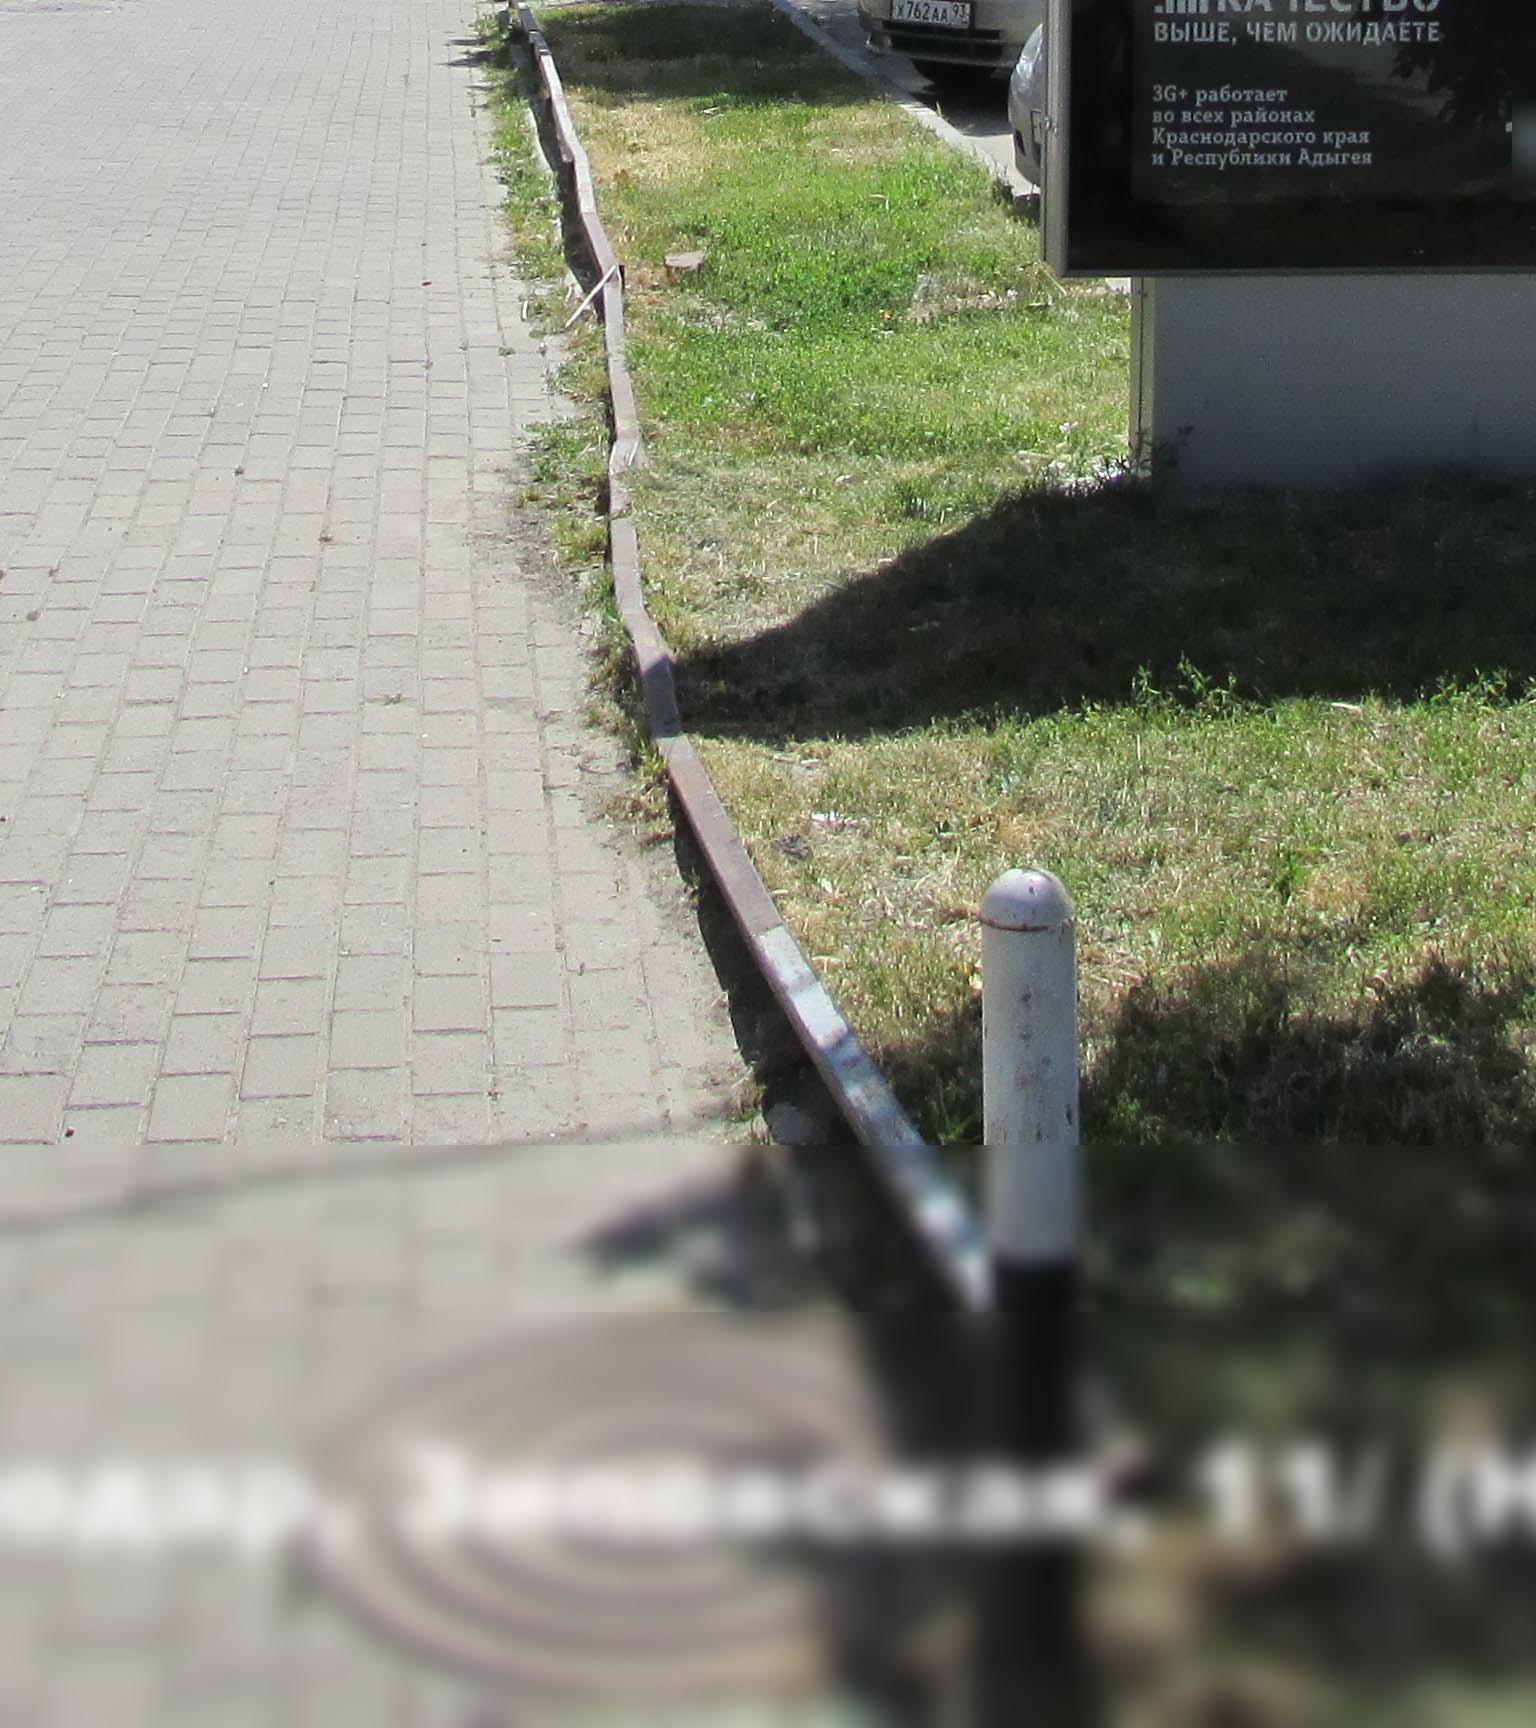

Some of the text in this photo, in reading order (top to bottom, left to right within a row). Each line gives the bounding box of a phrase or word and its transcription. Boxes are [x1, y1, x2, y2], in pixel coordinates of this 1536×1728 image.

[1153, 21, 1441, 46] ВЫШЕ, ЧЕМ ОЖИДАЕТЕ
[1152, 84, 1288, 106] 3G+ работает
[1152, 106, 1316, 128] во всех районах
[1152, 127, 1370, 149] Краснодарского края
[1171, 148, 1292, 170] Республики
[1298, 148, 1373, 169] Адыгея
